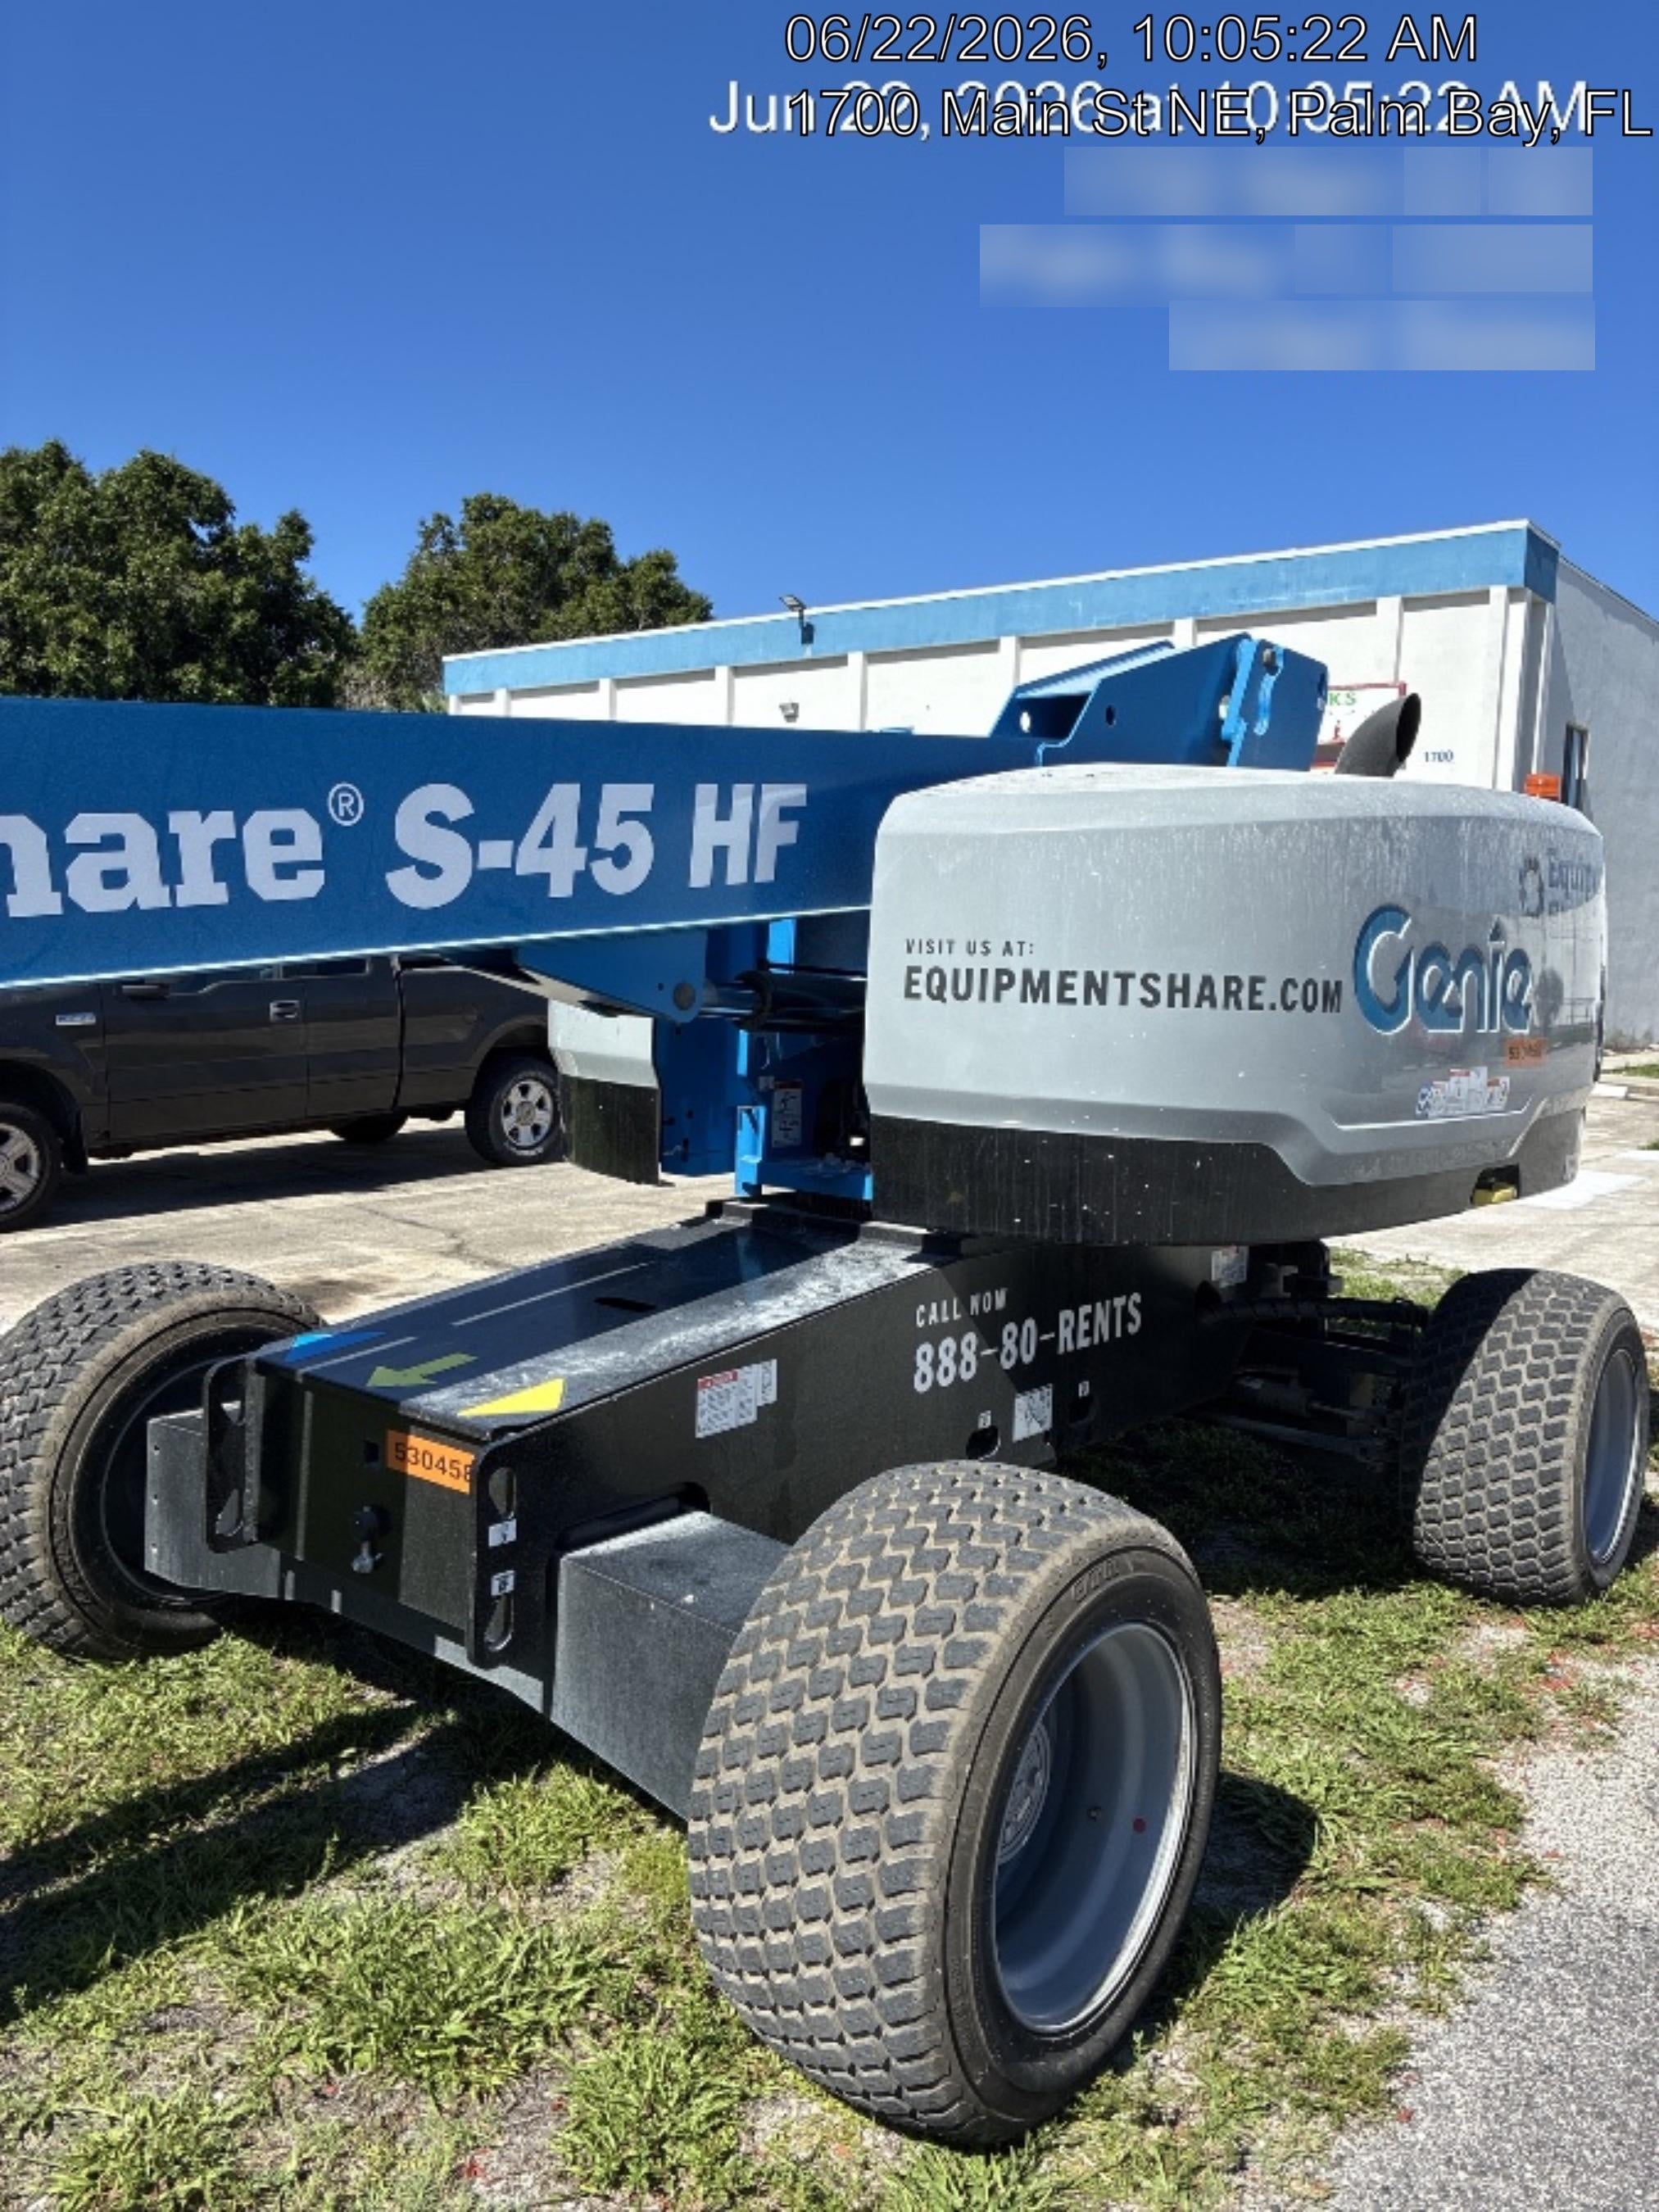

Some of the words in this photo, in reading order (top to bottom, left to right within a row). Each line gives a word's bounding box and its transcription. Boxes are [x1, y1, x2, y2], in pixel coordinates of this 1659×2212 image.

[385, 783, 655, 910] S-45
[688, 783, 808, 888] HF
[906, 939, 954, 955] VISIT
[966, 941, 991, 956] US
[1002, 941, 1034, 957] AT:
[1354, 904, 1532, 1035] Genie
[904, 965, 1343, 1013] EQUIPMENTSHARE.COM
[913, 1292, 1141, 1394] 888-80-RENTS
[916, 1298, 961, 1328] CALL
[970, 1288, 1008, 1316] NOW
